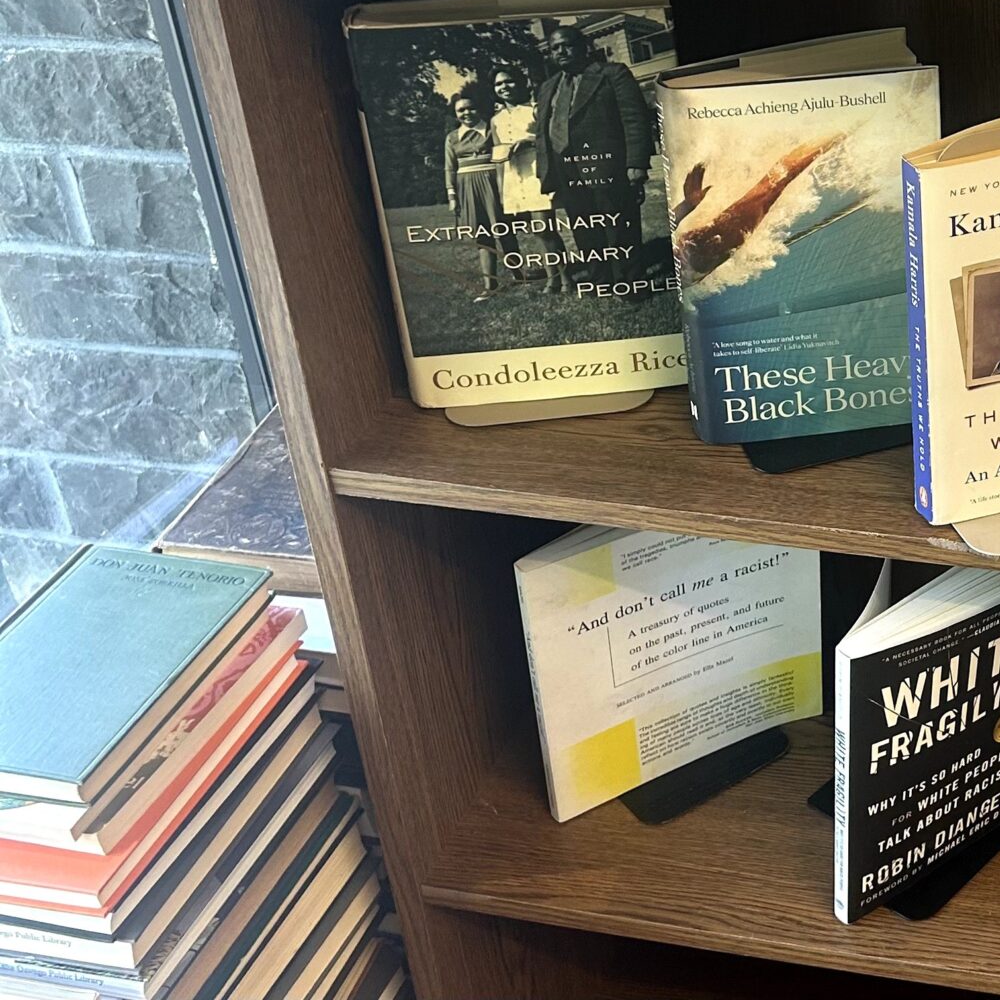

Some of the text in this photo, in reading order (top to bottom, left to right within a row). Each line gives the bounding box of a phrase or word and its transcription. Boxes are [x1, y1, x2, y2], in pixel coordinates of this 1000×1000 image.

[688, 92, 886, 119] Rebecca Achieng Ajulu-Bushell
[564, 153, 612, 162] MEMOIR
[569, 177, 614, 186] FAMILY
[906, 181, 920, 308] Kamala Harris
[432, 352, 688, 390] Condoleezza Rice
[714, 365, 816, 393] These
[724, 392, 815, 424] Black
[965, 469, 988, 484] An
[91, 558, 125, 568] DON
[128, 563, 170, 575] JUAN
[178, 569, 246, 585] TENORIO
[615, 596, 654, 619] don't
[660, 584, 685, 602] call
[692, 576, 713, 591] me
[720, 573, 728, 582] a
[836, 727, 846, 769] WHITE
[836, 768, 846, 828] FRAGILITY
[868, 748, 981, 816] WHY IT'S SO HARD
[860, 873, 909, 907] FOREWORD
[912, 865, 923, 877] BY
[927, 835, 965, 865] MICHAEL
[969, 817, 990, 838] ERIC
[861, 844, 926, 894] ROBIN
